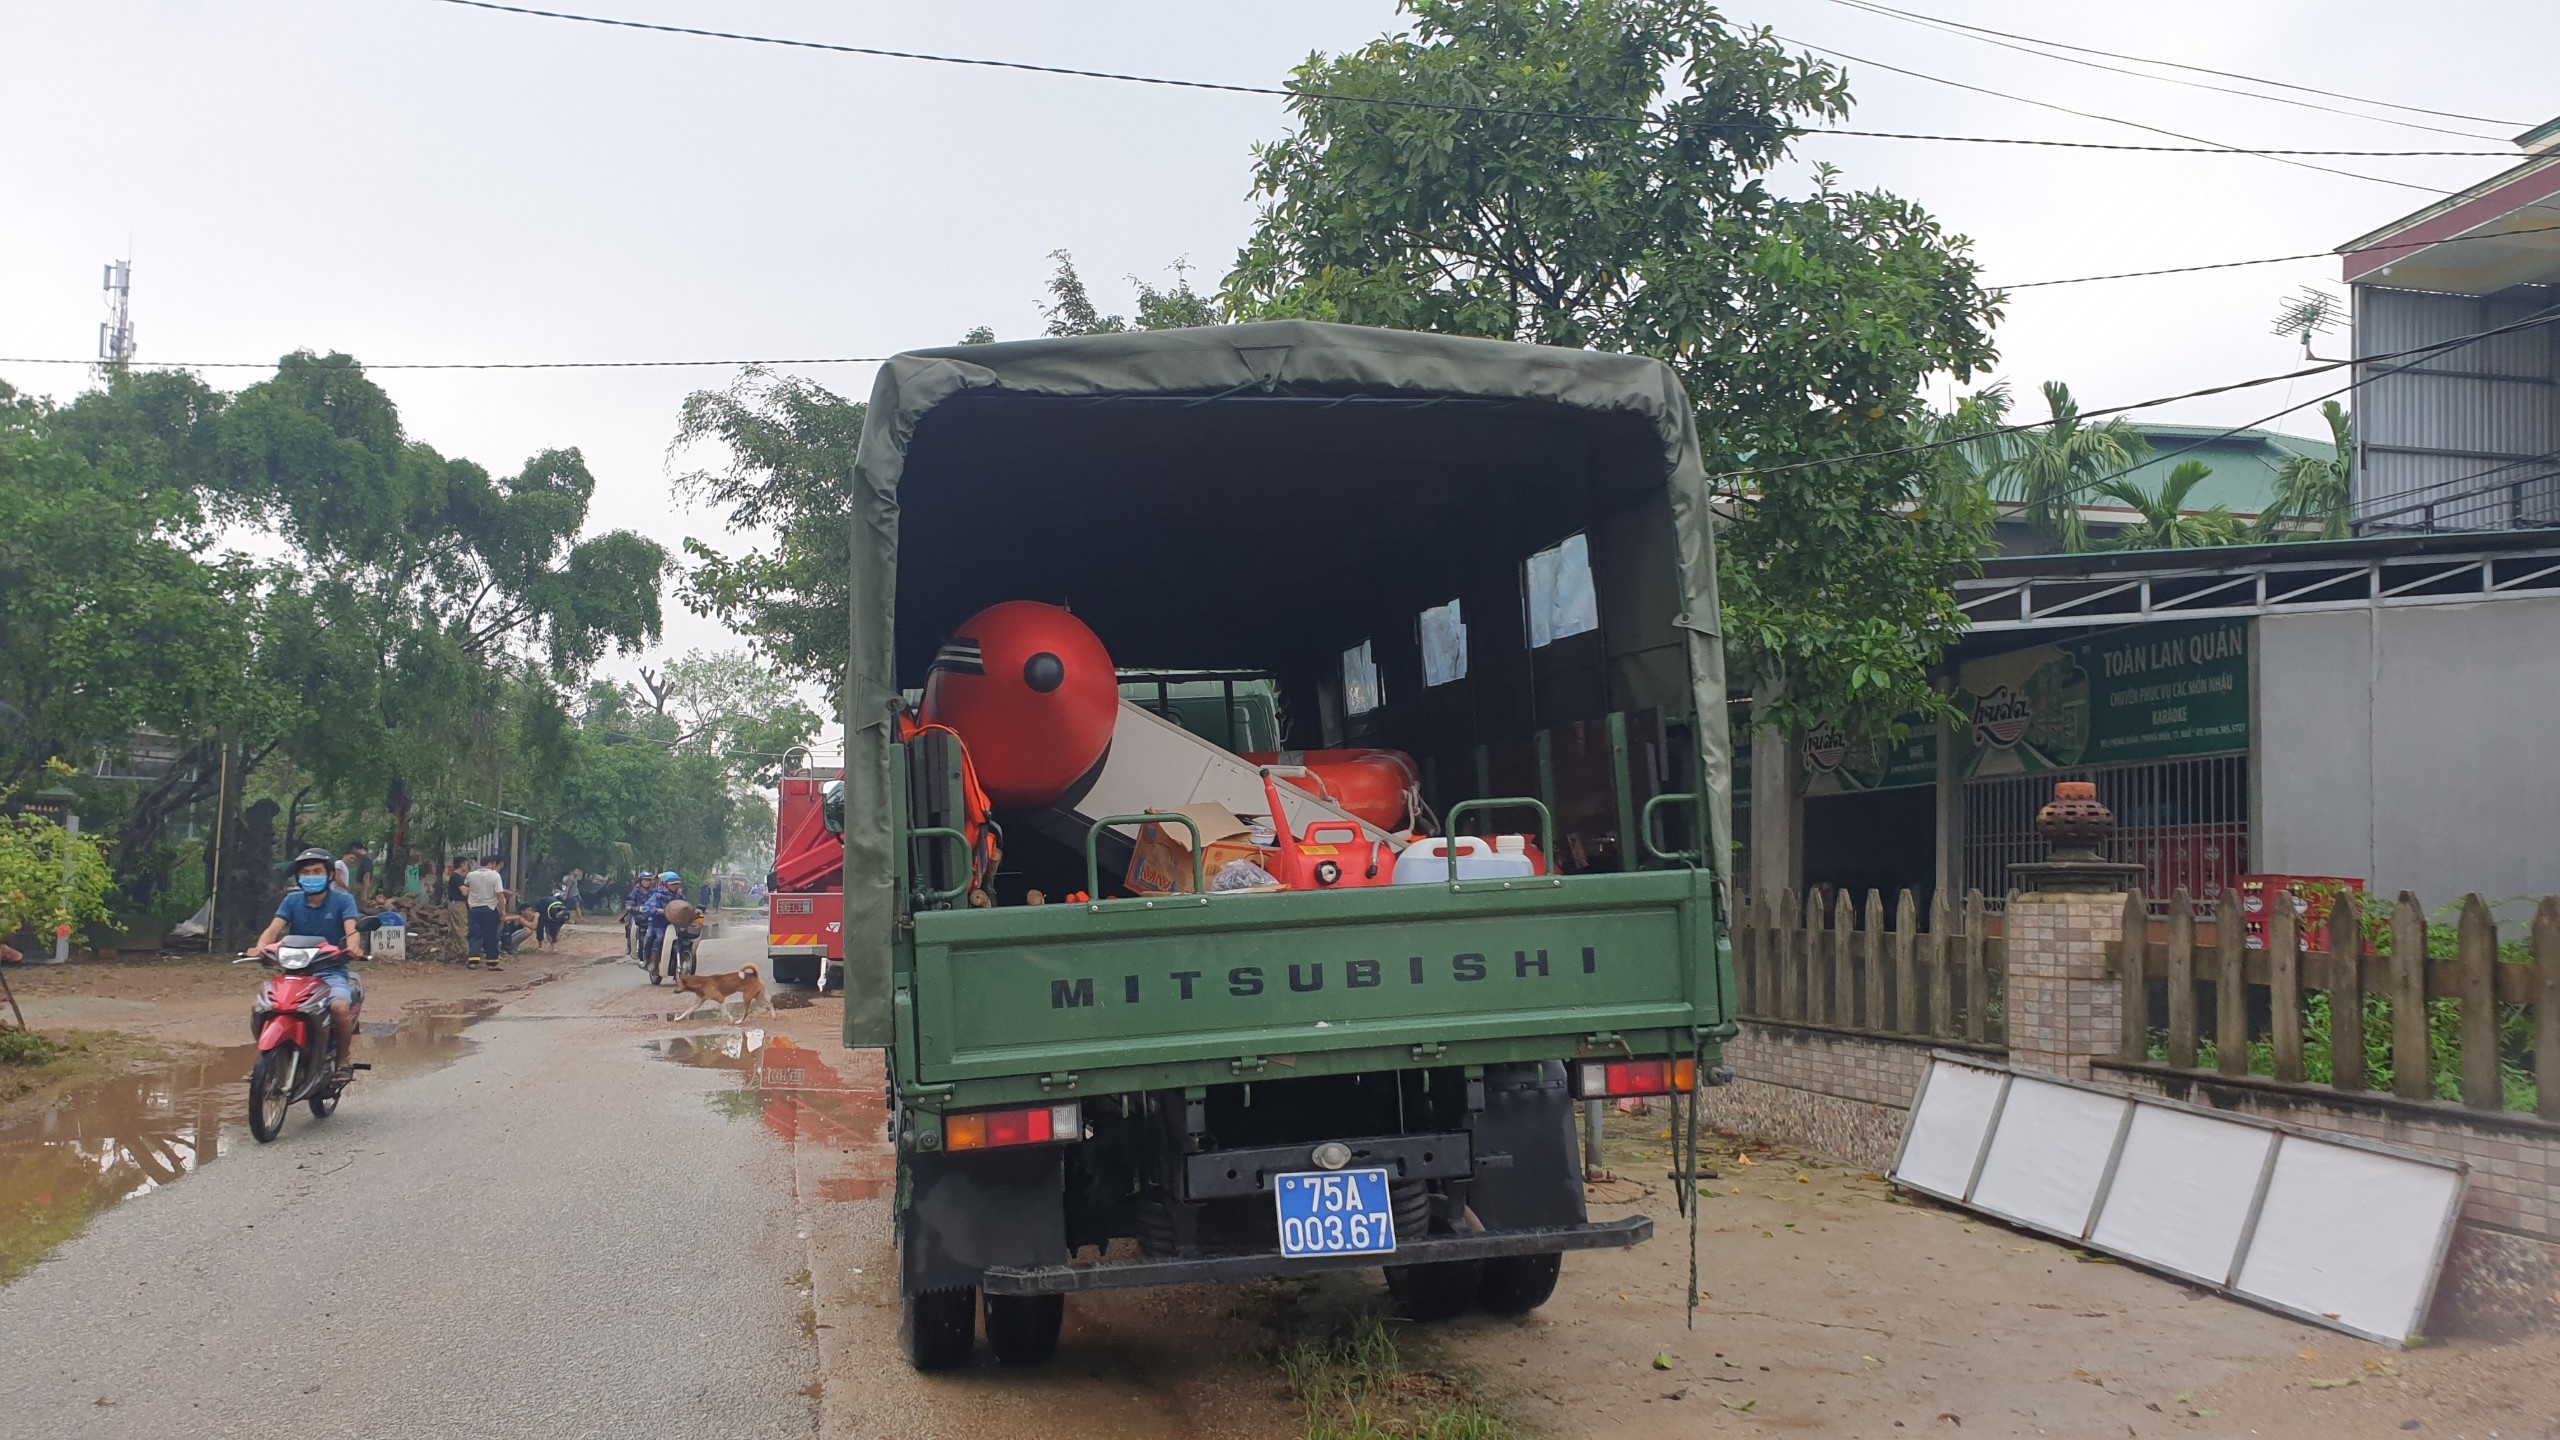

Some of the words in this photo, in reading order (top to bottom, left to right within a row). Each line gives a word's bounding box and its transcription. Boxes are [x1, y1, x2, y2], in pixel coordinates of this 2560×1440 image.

[2102, 643, 2146, 678] TOÀN
[2151, 637, 2185, 669] LAN
[2189, 624, 2243, 666] QUÁN
[2151, 706, 2189, 725] KARAOKE
[1050, 945, 1597, 1009] MITSUBISHI
[1303, 1175, 1364, 1213] 75A
[1284, 1212, 1388, 1252] 003.67
